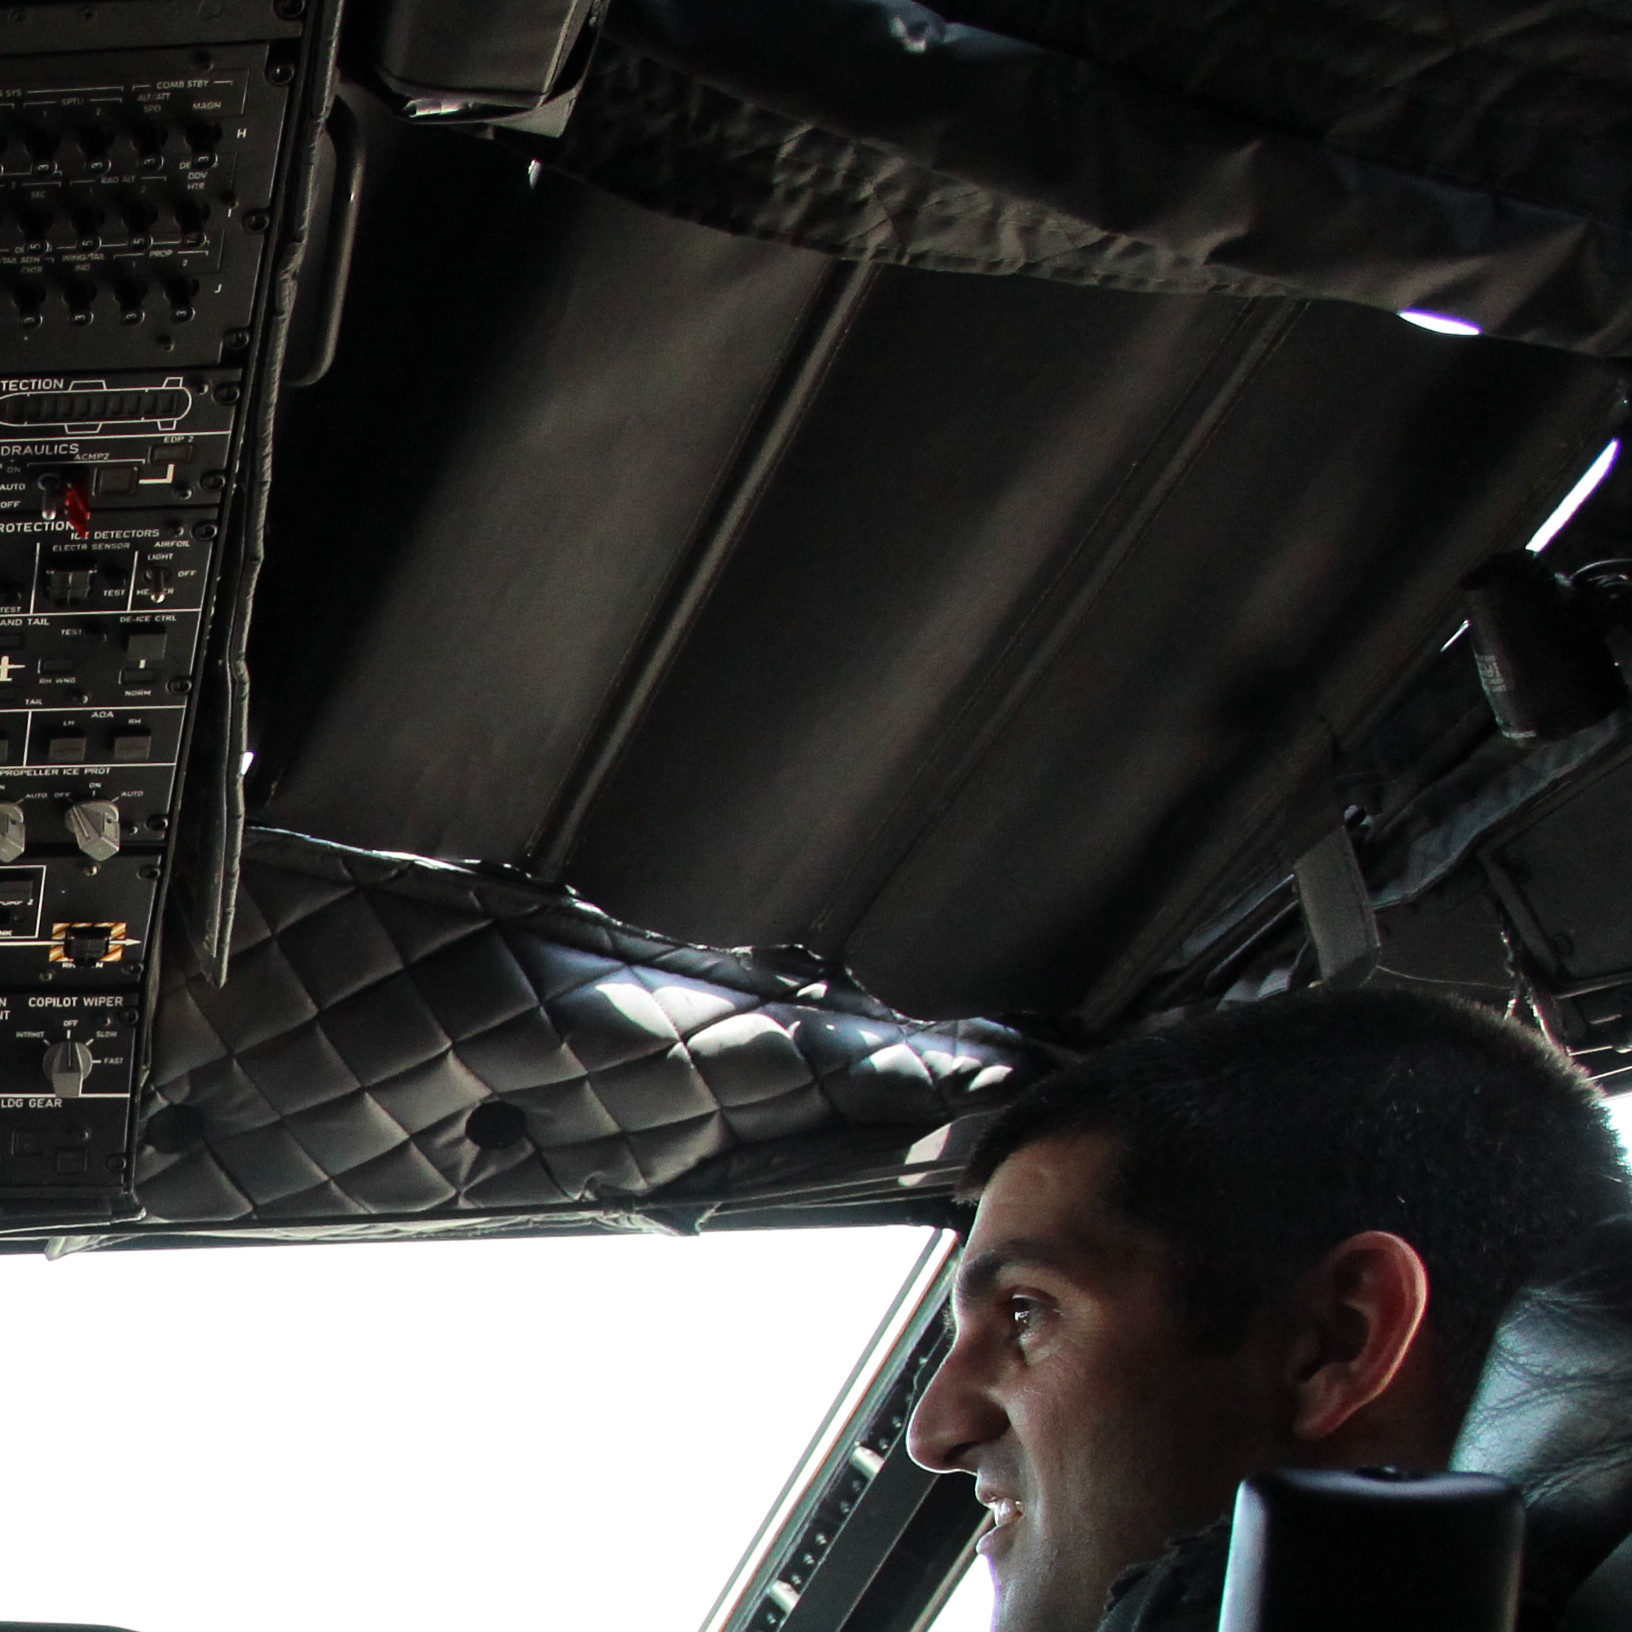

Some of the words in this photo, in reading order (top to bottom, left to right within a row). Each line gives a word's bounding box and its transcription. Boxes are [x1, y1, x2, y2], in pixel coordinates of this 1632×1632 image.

[0, 500, 21, 509] OFF
[91, 542, 130, 551] SENSOR
[154, 539, 191, 548] AIRFOIL
[147, 552, 174, 561] LIGHT
[177, 569, 198, 578] OFF
[102, 588, 125, 598] TEST
[0, 605, 21, 614] TEST
[0, 617, 21, 627] AND
[25, 616, 50, 627] TAIL
[0, 768, 60, 777] PROPELLER
[63, 768, 81, 776] ICE
[84, 767, 111, 776] PROT
[28, 997, 78, 1008] COPILOT
[83, 996, 123, 1007] WIPER
[1, 1099, 25, 1109] LDG
[29, 1098, 62, 1109] GEAR
